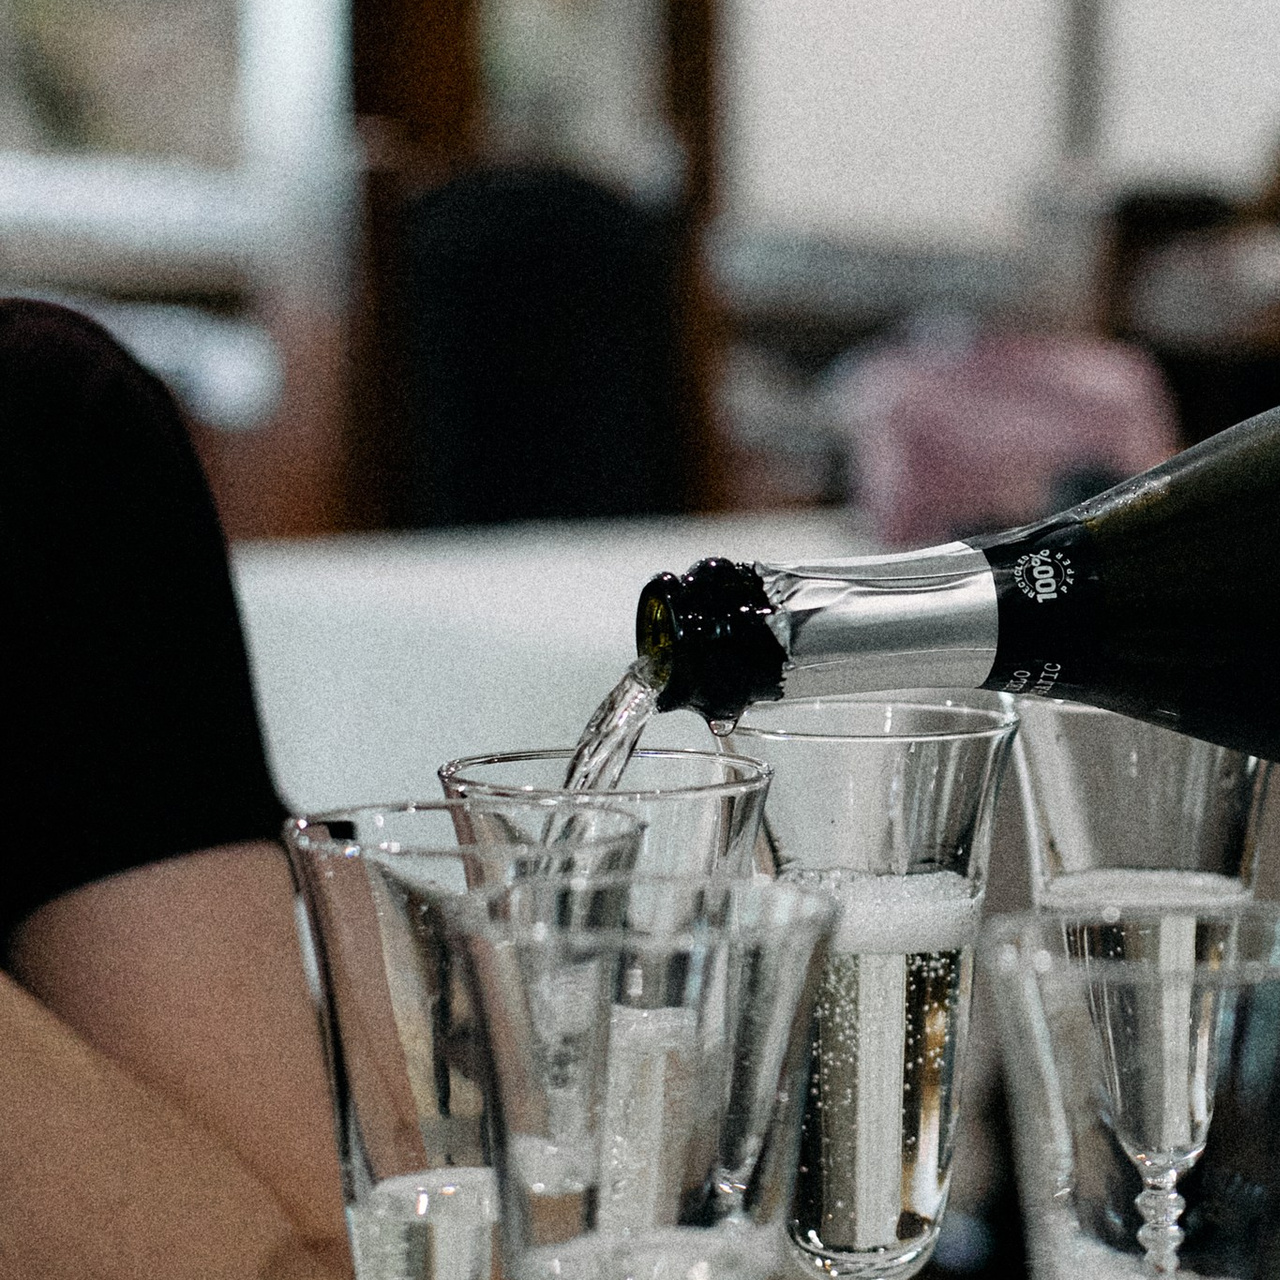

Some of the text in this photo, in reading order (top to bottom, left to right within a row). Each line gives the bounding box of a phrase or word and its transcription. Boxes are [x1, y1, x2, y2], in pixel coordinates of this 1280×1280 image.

[1014, 555, 1035, 599] RECYCLED
[1029, 549, 1058, 604] 100%
[1055, 552, 1075, 594] PAPER
